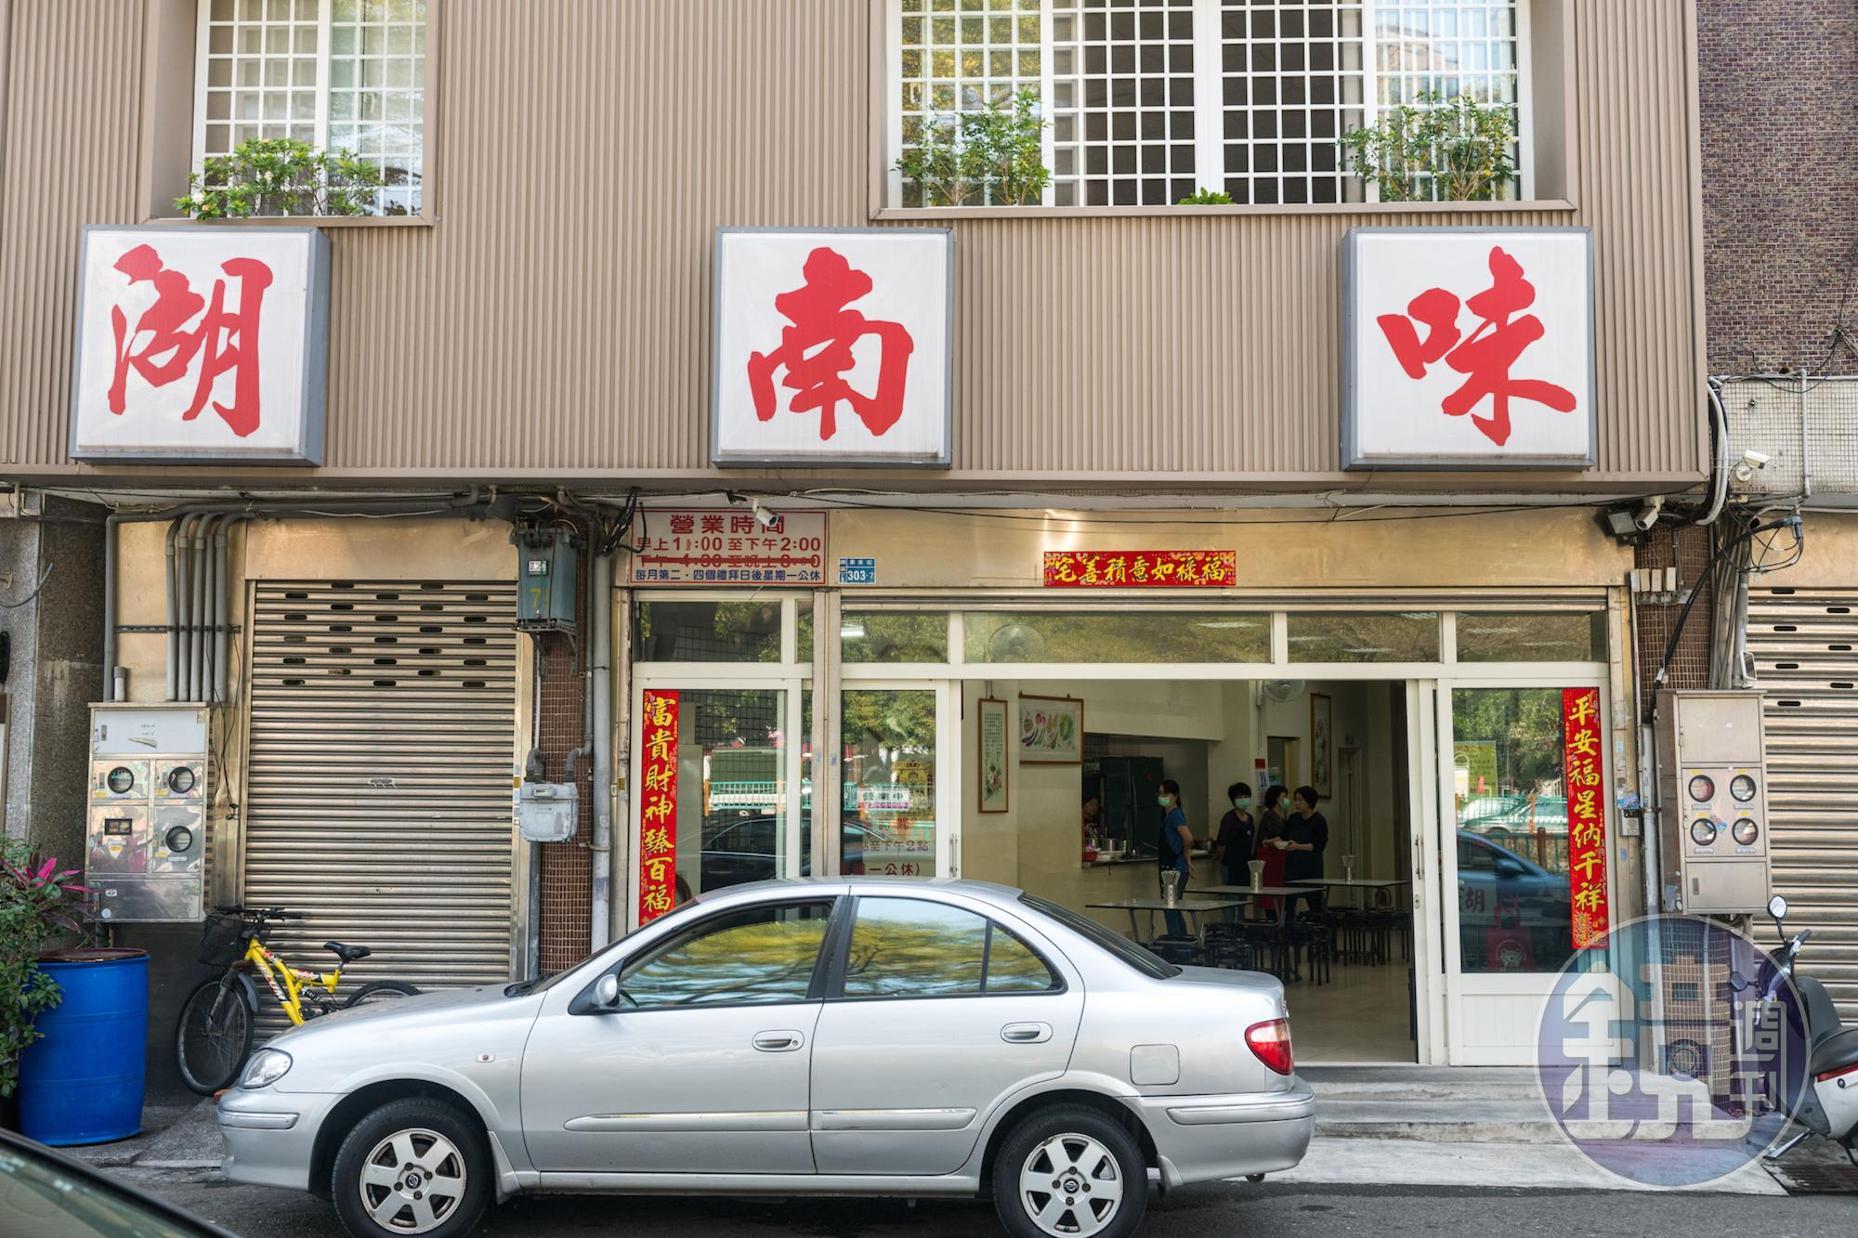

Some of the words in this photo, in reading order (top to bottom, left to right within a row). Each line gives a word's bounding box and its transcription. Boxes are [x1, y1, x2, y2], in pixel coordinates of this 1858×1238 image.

[107, 244, 273, 438] 湖
[747, 247, 914, 441] 南
[1376, 246, 1577, 447] 味
[670, 514, 785, 534] 營業時間
[1568, 695, 1605, 914] 平安福星納千祥
